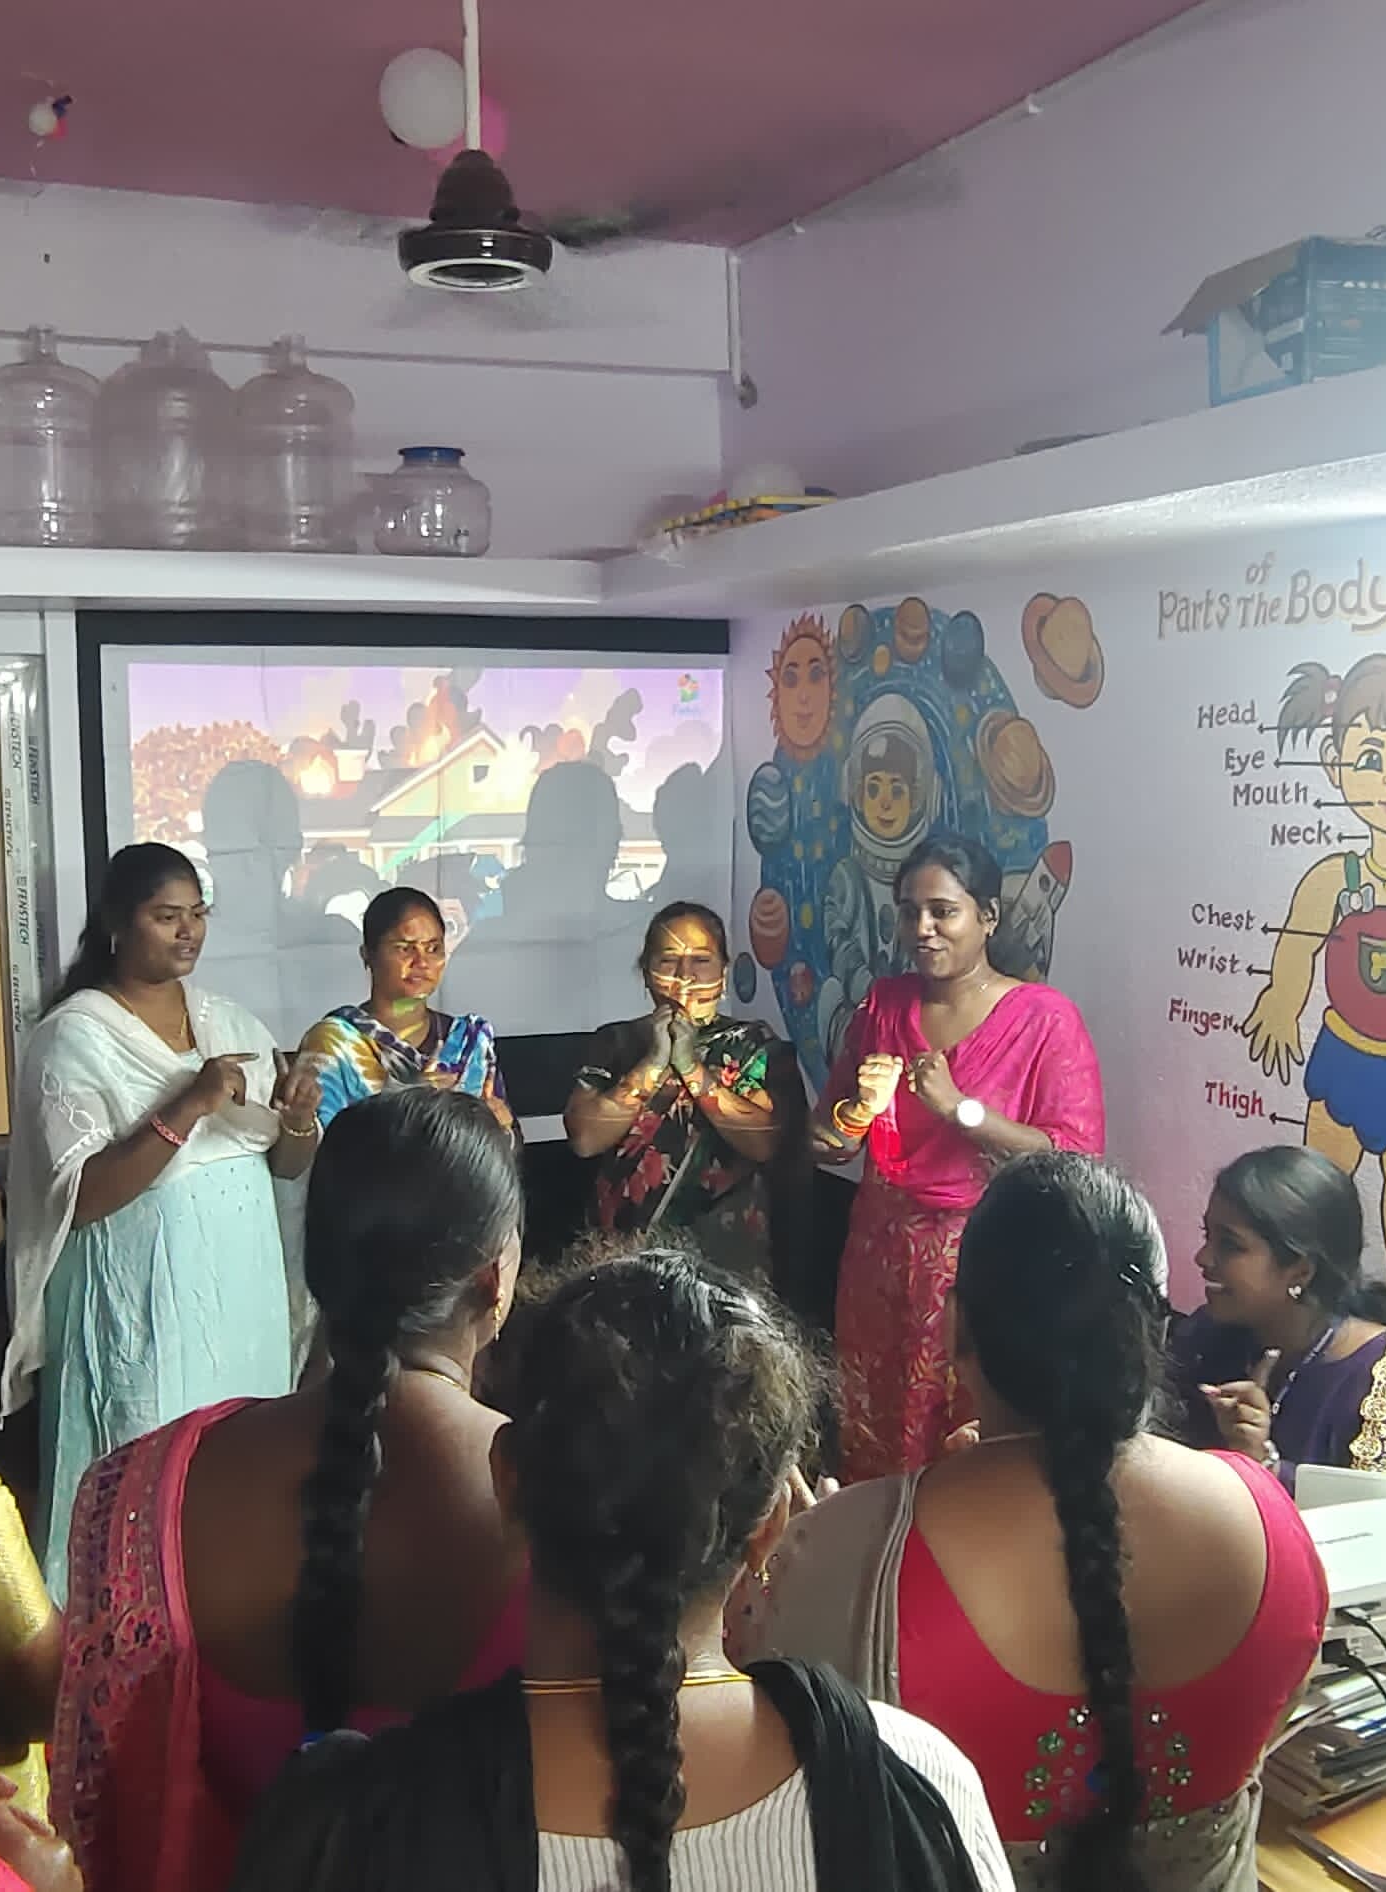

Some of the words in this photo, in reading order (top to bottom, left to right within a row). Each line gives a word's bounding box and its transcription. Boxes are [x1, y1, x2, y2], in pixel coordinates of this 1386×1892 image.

[1157, 585, 1231, 640] Parts
[1237, 592, 1282, 630] The
[1197, 701, 1258, 729] Head
[1224, 747, 1266, 775] Eye
[1232, 783, 1309, 807] Mouth
[1270, 820, 1333, 846] Neck
[17, 888, 29, 946] FENSTECH
[1191, 903, 1255, 930] Chest
[1176, 947, 1240, 974] Wrist
[1168, 997, 1234, 1036] Finger
[1204, 1081, 1265, 1118] Thigh
